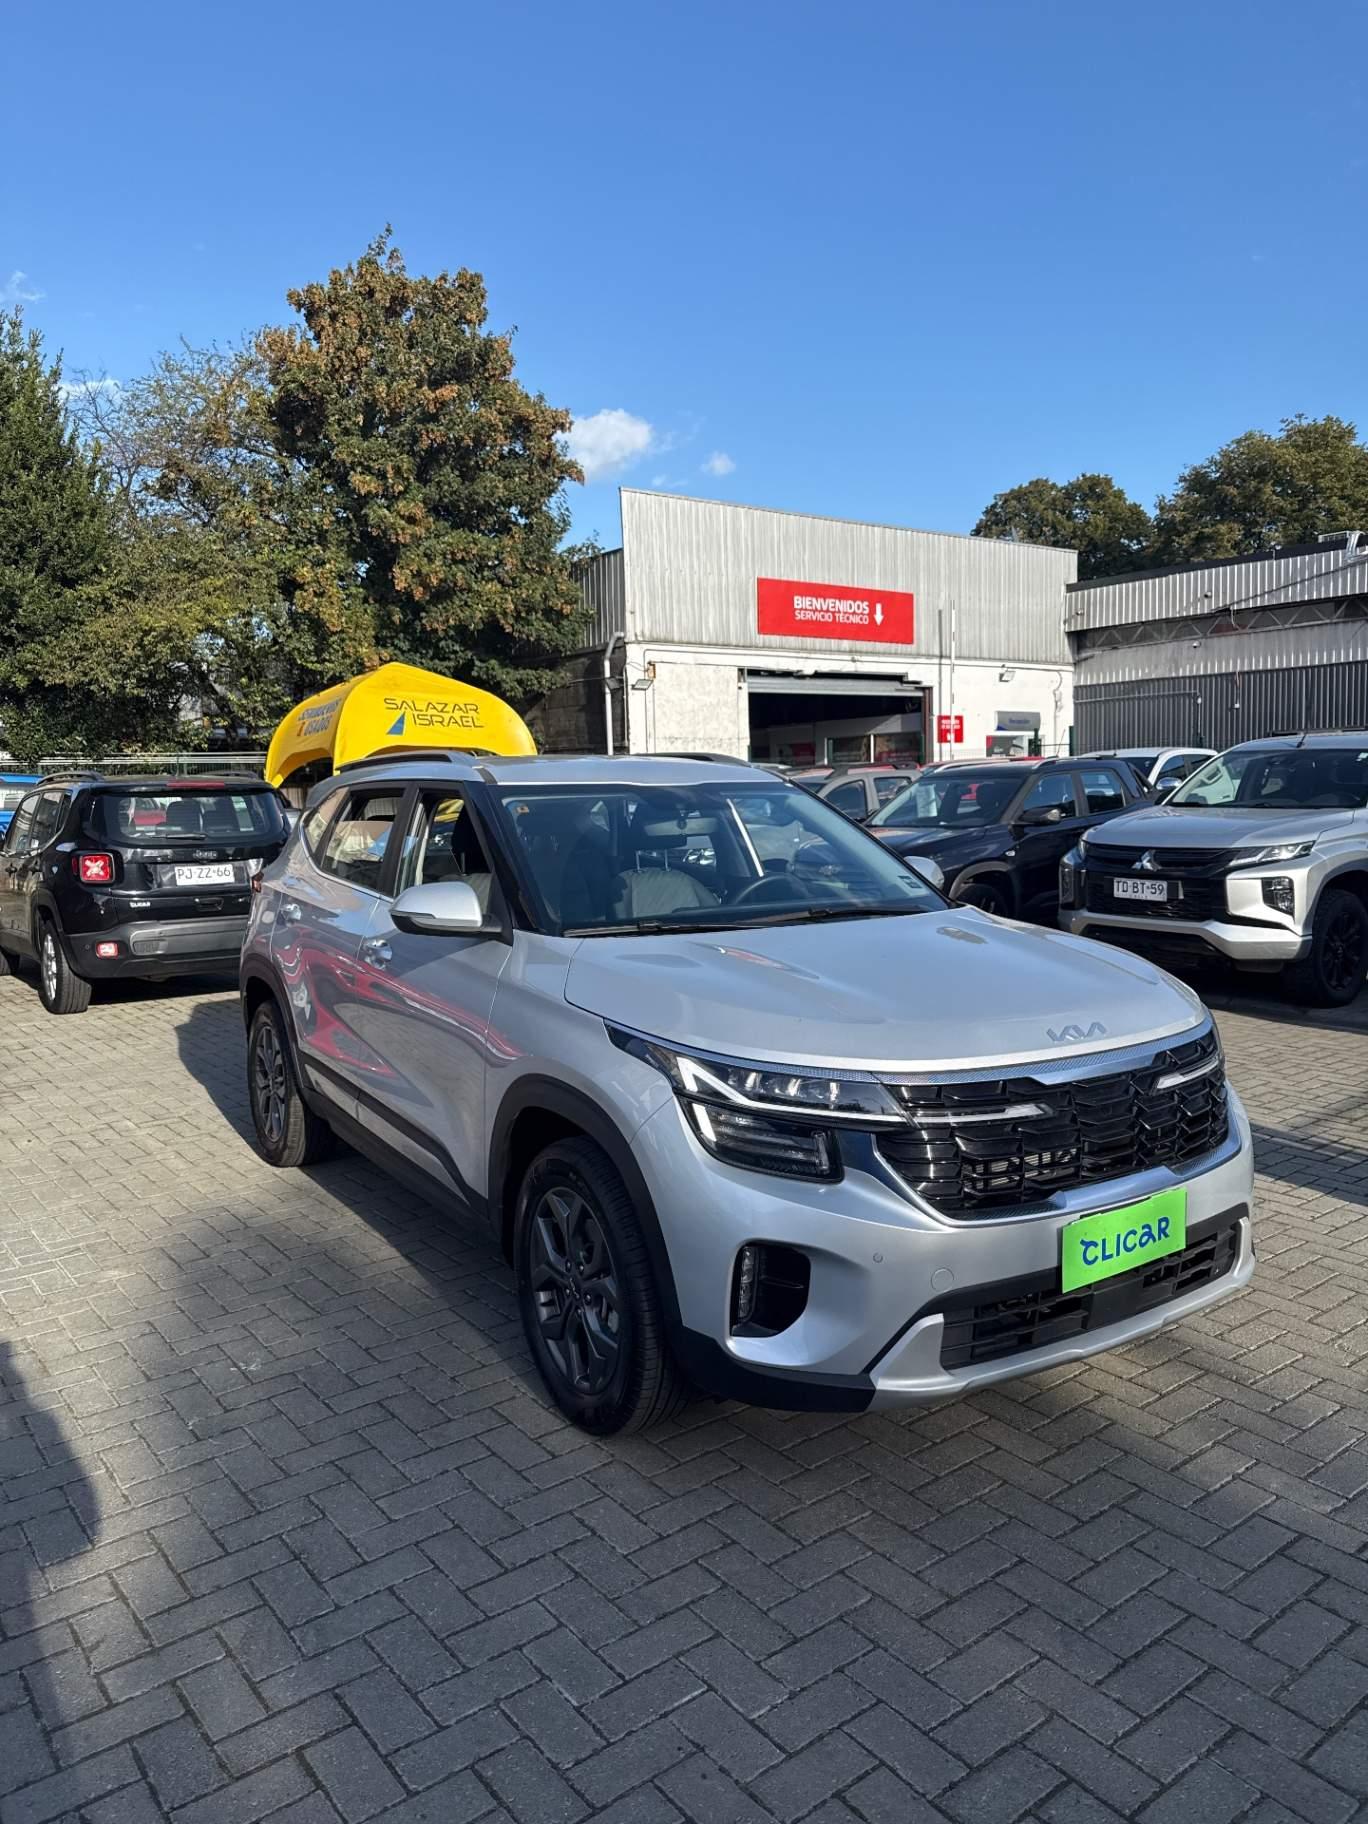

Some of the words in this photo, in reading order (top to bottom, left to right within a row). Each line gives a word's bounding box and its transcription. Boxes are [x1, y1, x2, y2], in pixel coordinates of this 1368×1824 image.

[793, 595, 869, 614] BIENVENIDOS
[794, 610, 833, 622] SERVICIO
[384, 697, 480, 714] SALAZAR
[412, 713, 484, 728] ISRAEL
